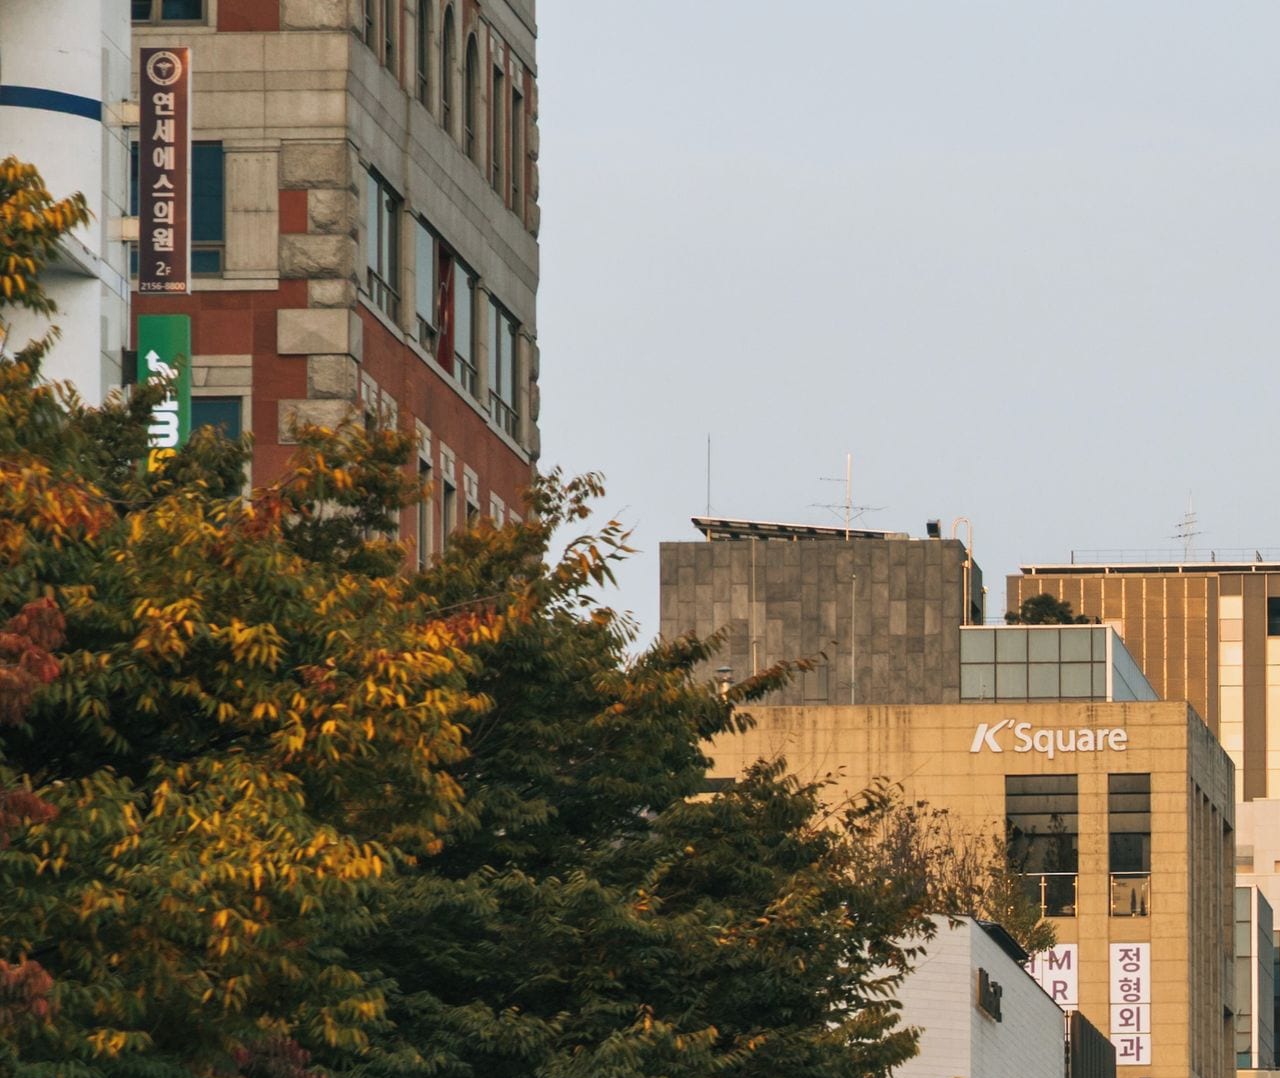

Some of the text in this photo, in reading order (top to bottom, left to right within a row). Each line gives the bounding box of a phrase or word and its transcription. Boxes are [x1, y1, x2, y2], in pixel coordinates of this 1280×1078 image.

[152, 92, 175, 252] 연세에스의원
[140, 281, 186, 291] 2156-8800
[155, 261, 171, 276] 2F
[1118, 947, 1144, 1062] 정형외과
